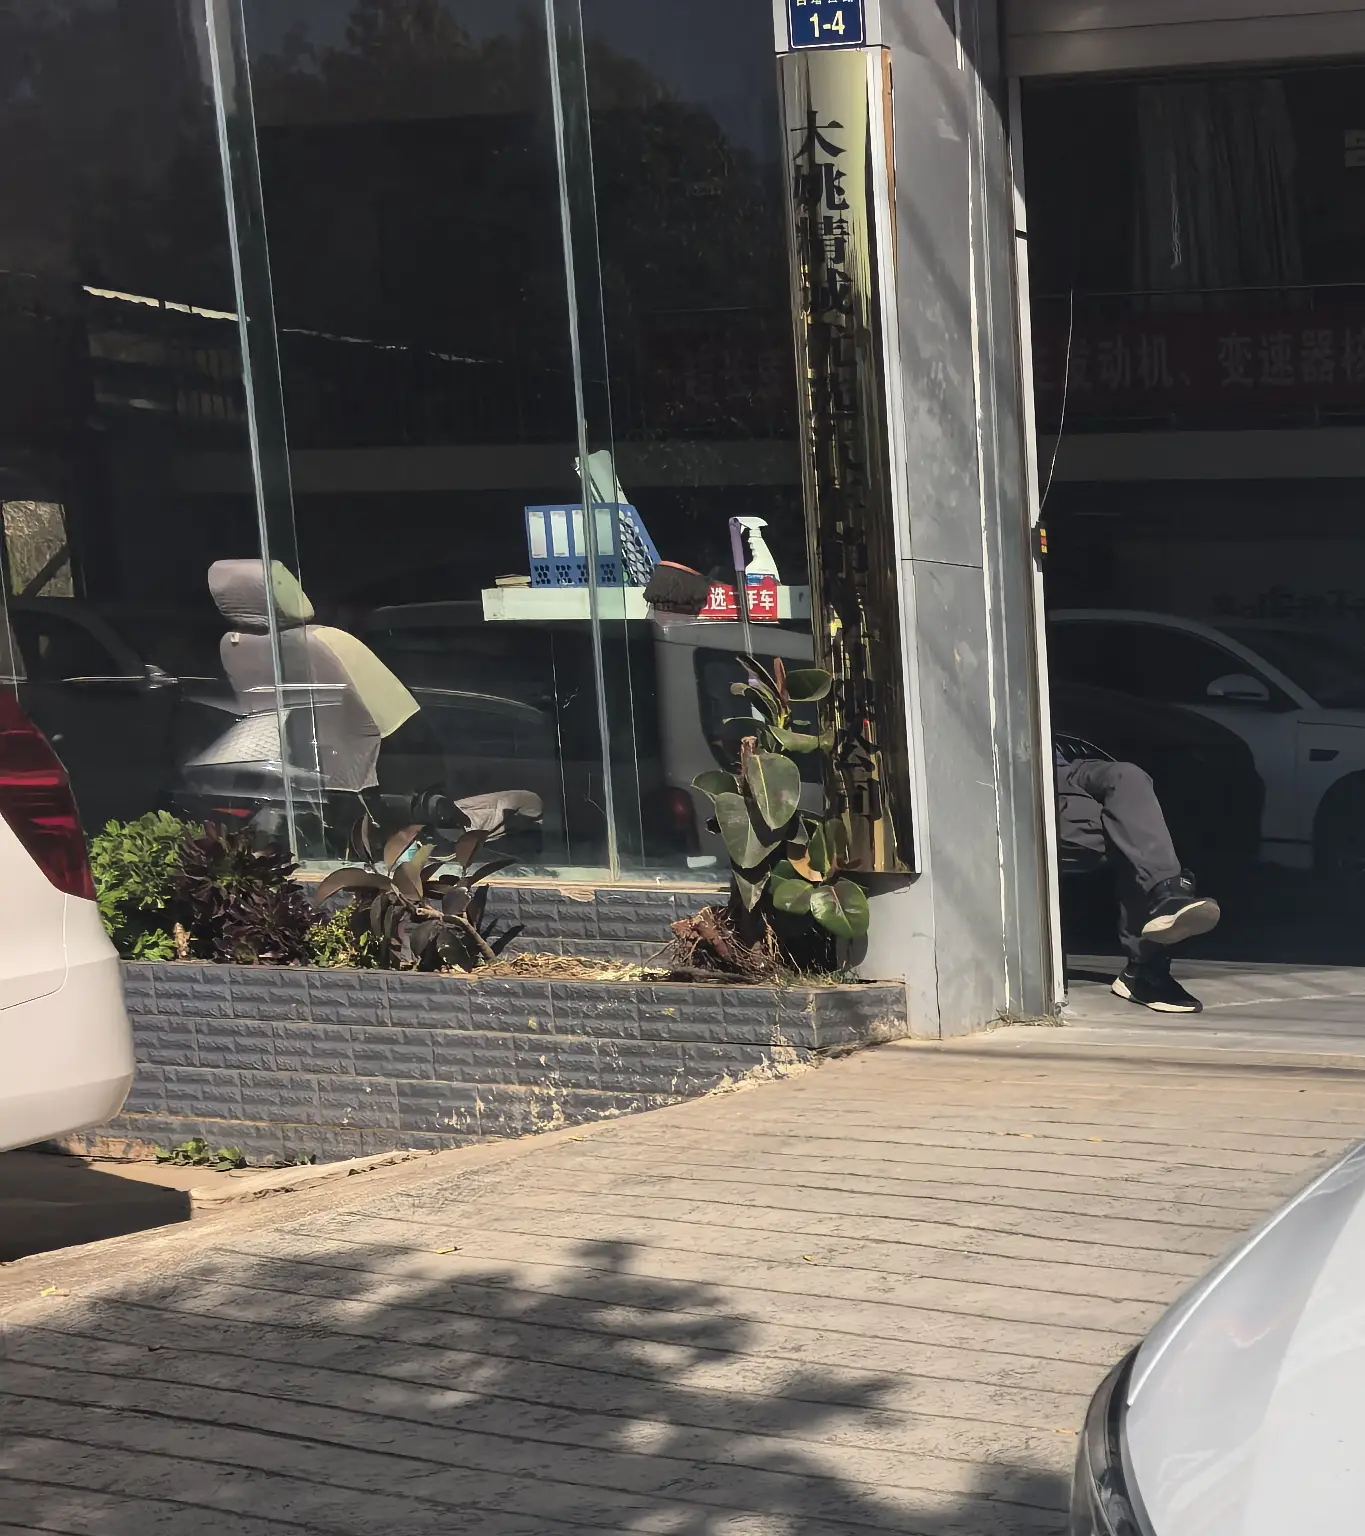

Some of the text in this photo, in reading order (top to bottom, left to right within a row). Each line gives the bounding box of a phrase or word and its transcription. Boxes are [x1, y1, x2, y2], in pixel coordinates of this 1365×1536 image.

[809, 11, 845, 37] 1-4
[702, 587, 775, 611] 选二手车
